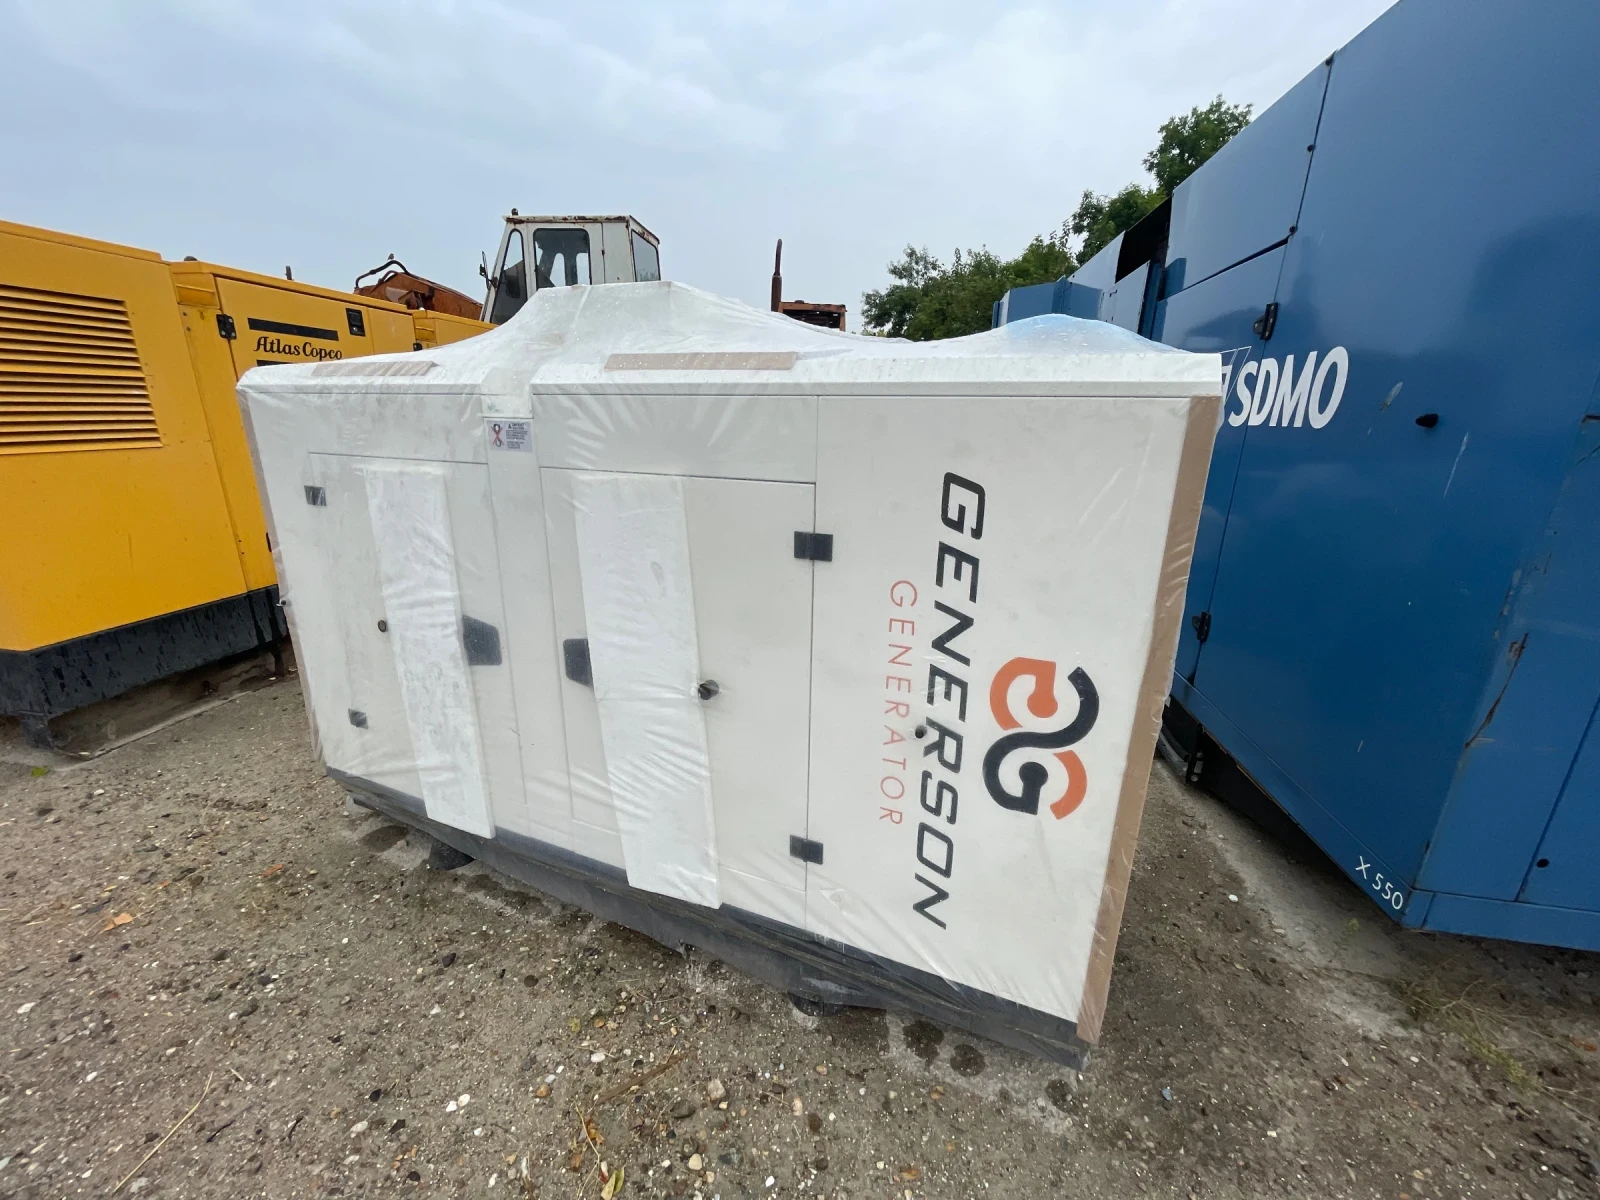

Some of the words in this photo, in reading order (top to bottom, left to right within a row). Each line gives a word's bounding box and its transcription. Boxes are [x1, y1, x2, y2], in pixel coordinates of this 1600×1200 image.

[254, 336, 301, 356] Atlas
[302, 341, 342, 361] Copco
[1228, 346, 1349, 429] SDMO
[880, 580, 918, 825] GENERATOR
[912, 472, 986, 929] GENERSON
[1355, 855, 1371, 880] X
[1372, 872, 1403, 910] 550
